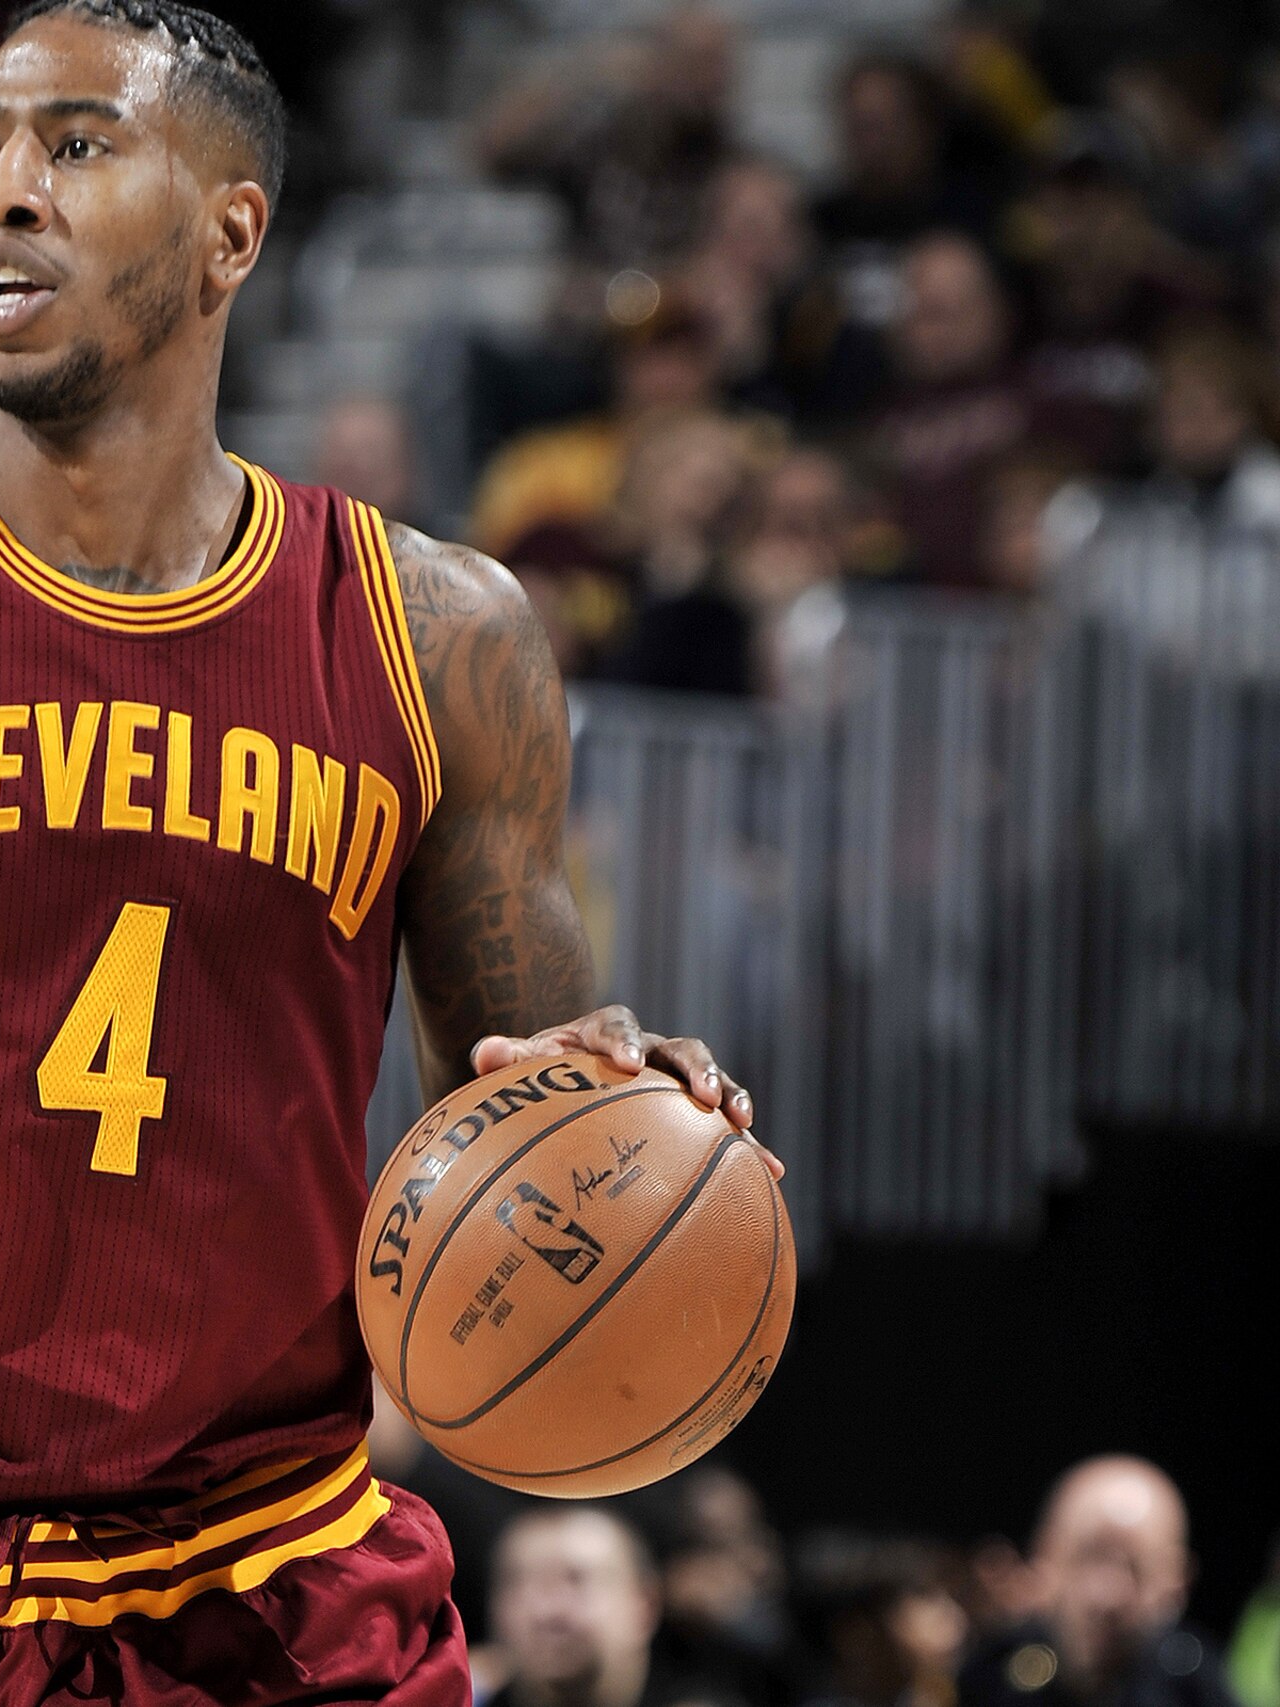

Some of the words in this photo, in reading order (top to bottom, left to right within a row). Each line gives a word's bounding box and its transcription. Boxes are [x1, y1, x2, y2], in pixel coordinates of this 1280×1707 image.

[36, 902, 171, 1176] 4
[370, 1062, 597, 1297] SPALDING
[450, 1302, 485, 1346] OFFICIAL
[475, 1274, 505, 1308] GAME
[495, 1251, 526, 1281] BALL
